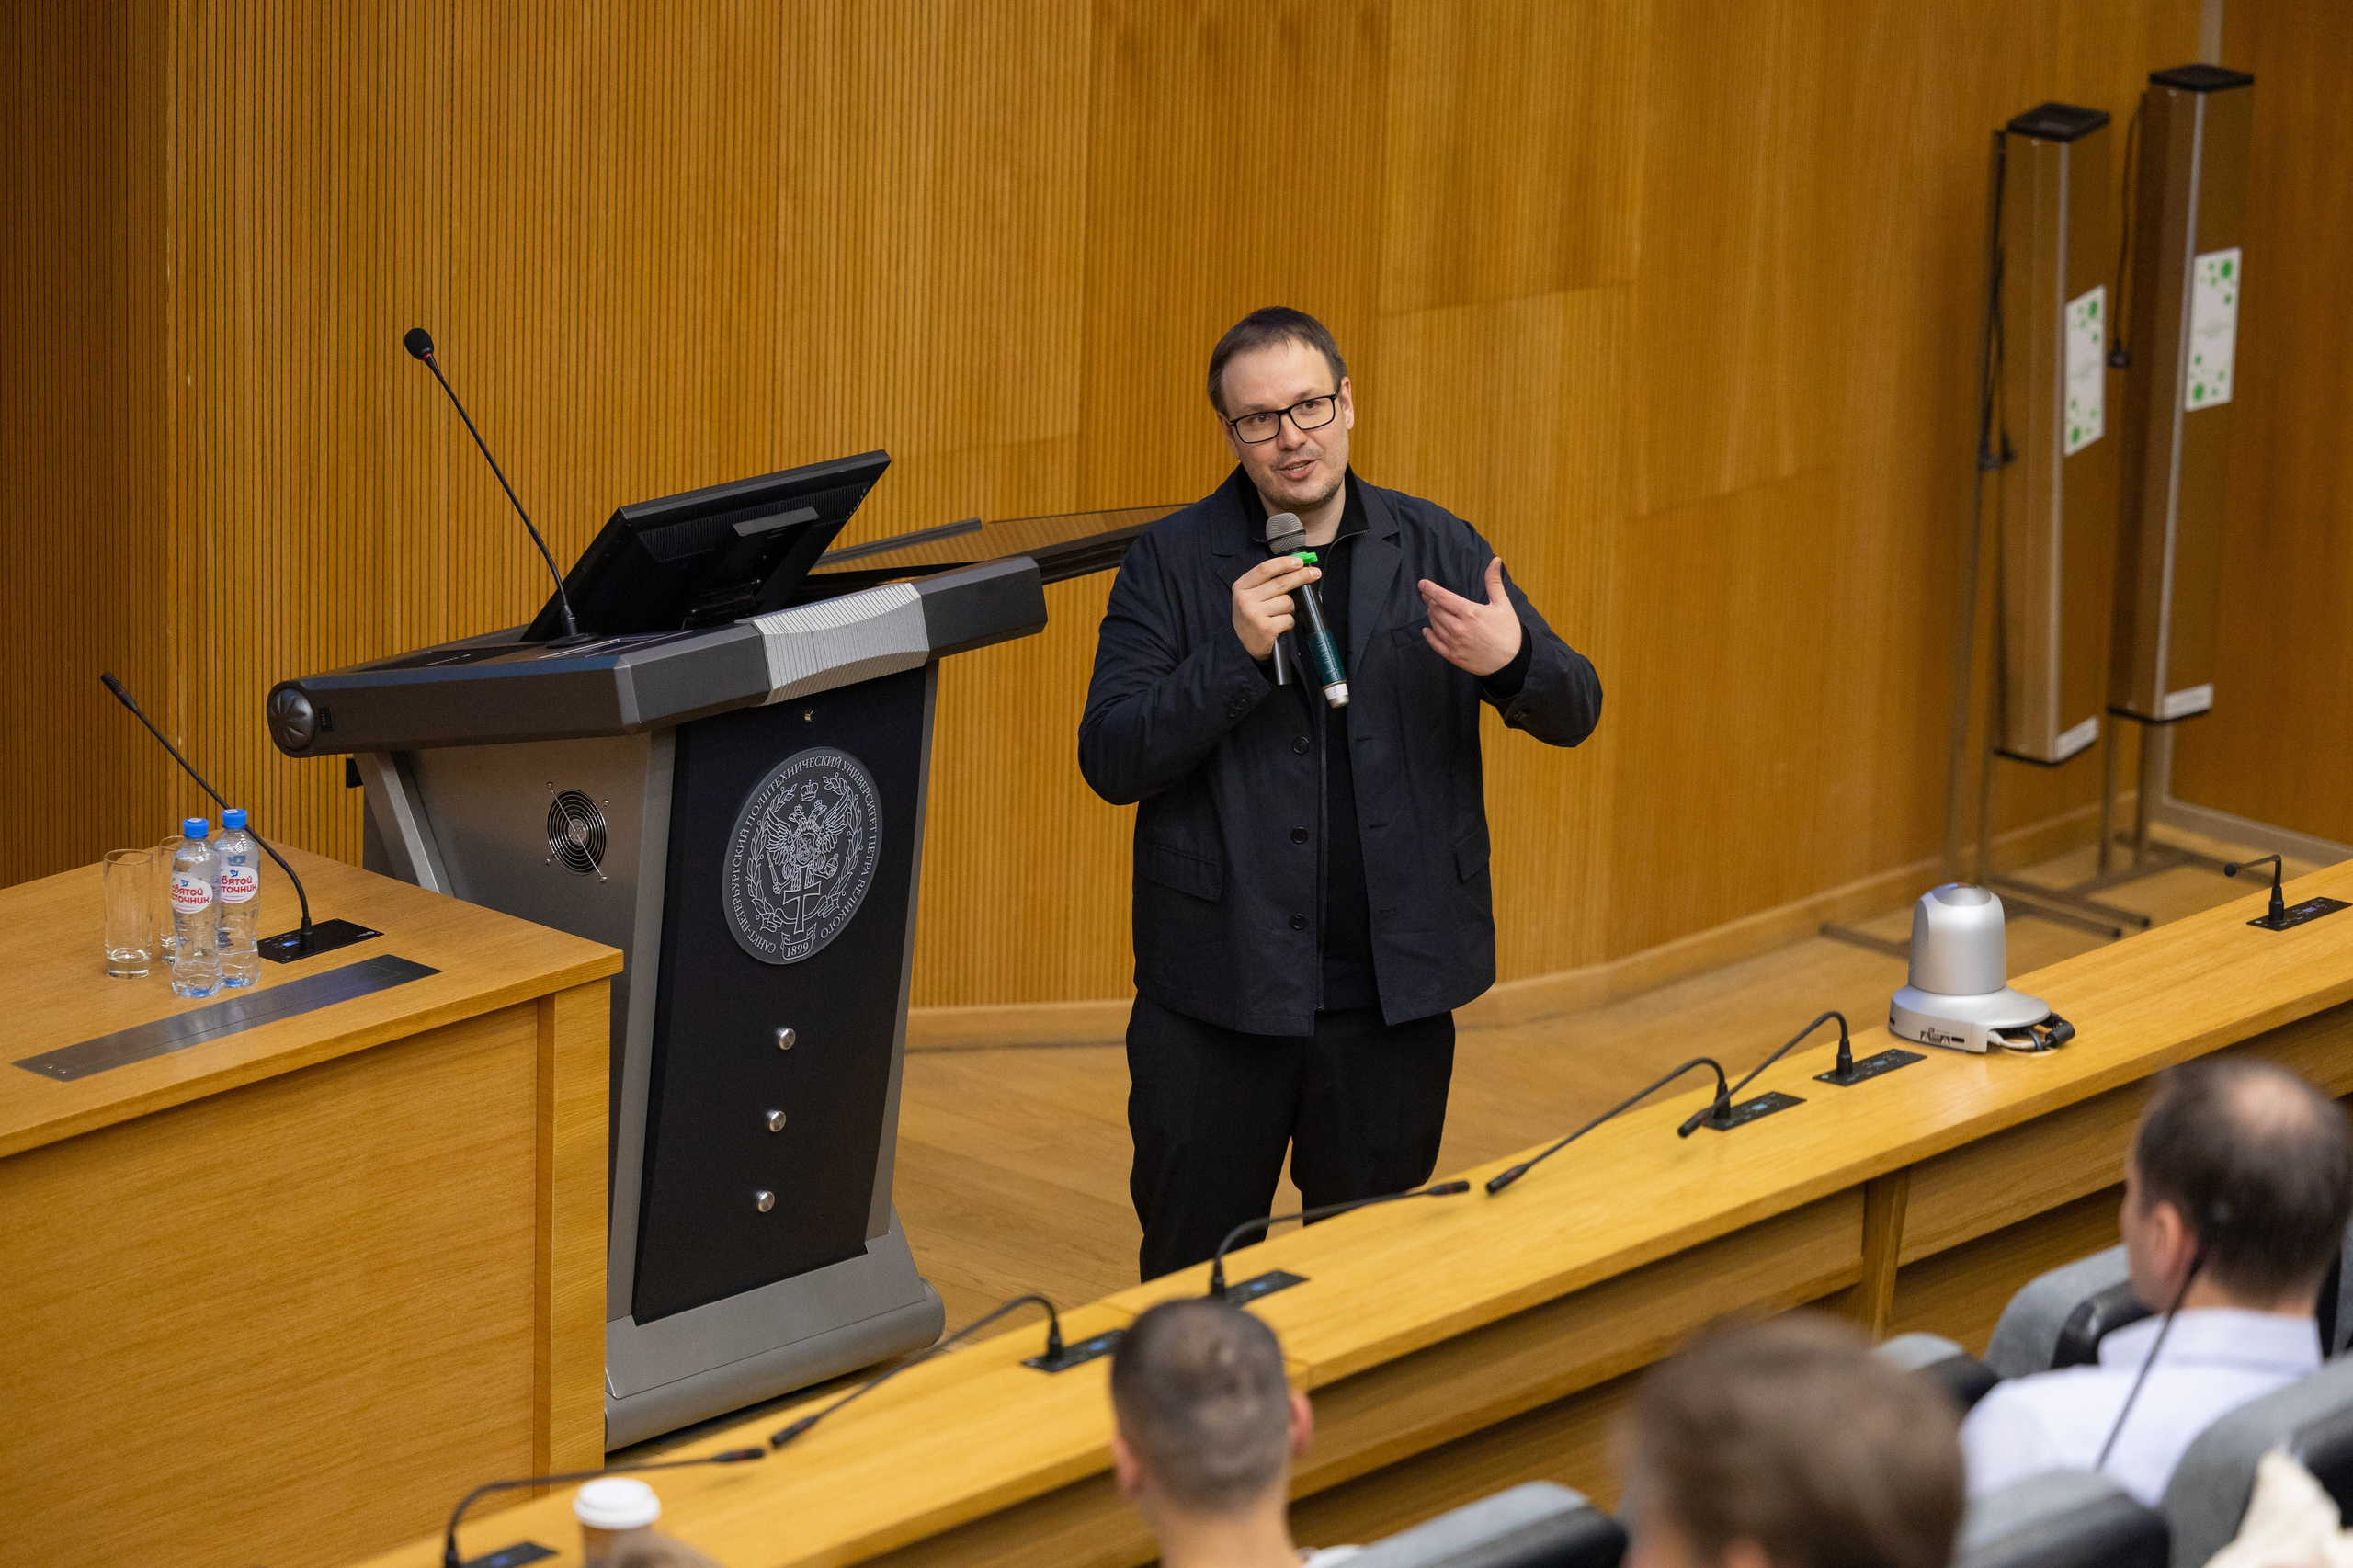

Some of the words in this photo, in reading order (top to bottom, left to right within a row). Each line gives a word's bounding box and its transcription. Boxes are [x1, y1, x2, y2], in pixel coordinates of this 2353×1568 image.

[745, 756, 842, 826] ПОЛИТЕХНИЧЕСКИЙ
[842, 761, 878, 832] УНИВЕРСИТЕТ
[861, 835, 877, 876] ПЕТРА
[171, 892, 209, 904] сточник
[221, 884, 256, 893] точник
[222, 875, 253, 885] вятой
[732, 829, 776, 953] САНКТ-ПЕТЕРБУРГСКИЙ
[821, 879, 865, 939] ВЕЛИКОГО
[786, 942, 809, 957] 1899
